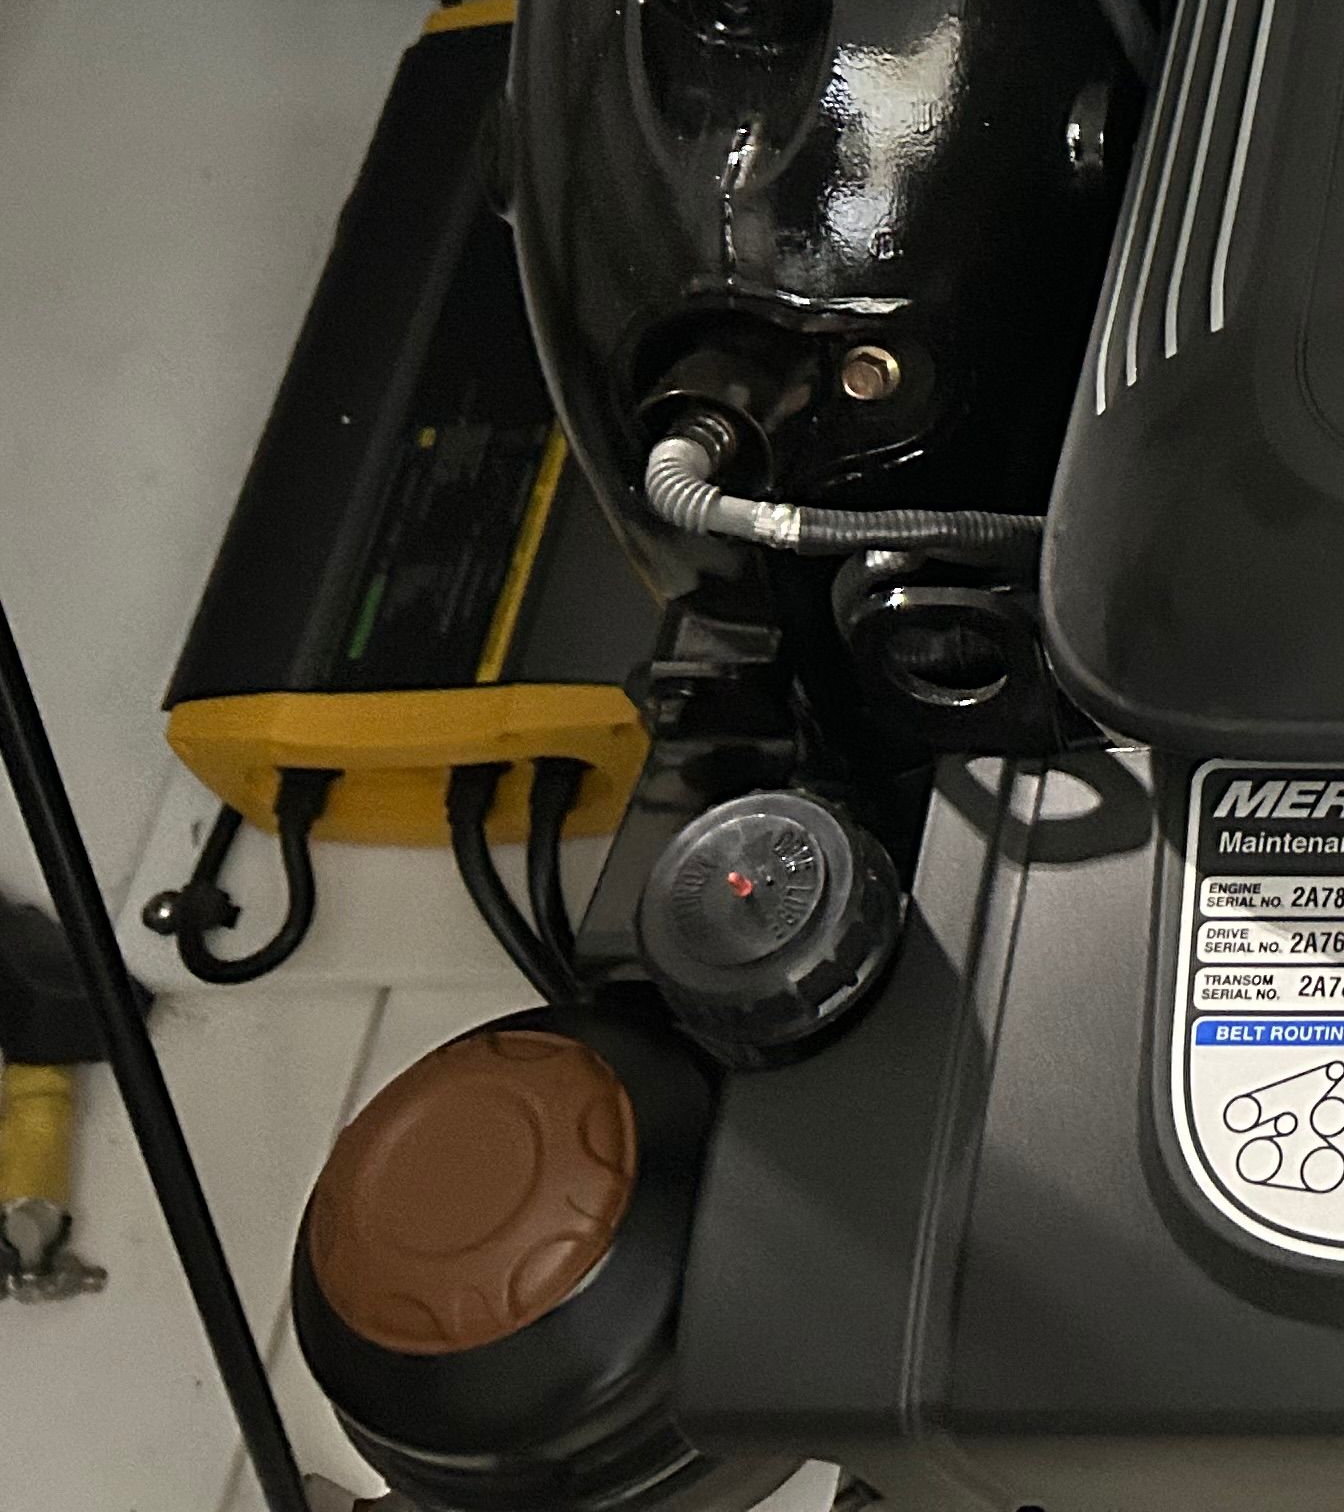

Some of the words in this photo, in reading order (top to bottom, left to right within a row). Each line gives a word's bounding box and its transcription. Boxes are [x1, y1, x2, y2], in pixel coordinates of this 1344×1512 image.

[1209, 882, 1262, 894] ENGINE
[1207, 896, 1256, 907] SERIAL
[1207, 928, 1248, 939] DRIVE
[1204, 942, 1254, 953] SERIAL
[1204, 974, 1273, 985] TRANSOM
[1202, 988, 1251, 999] SERIAL
[1216, 1026, 1265, 1040] BELT
